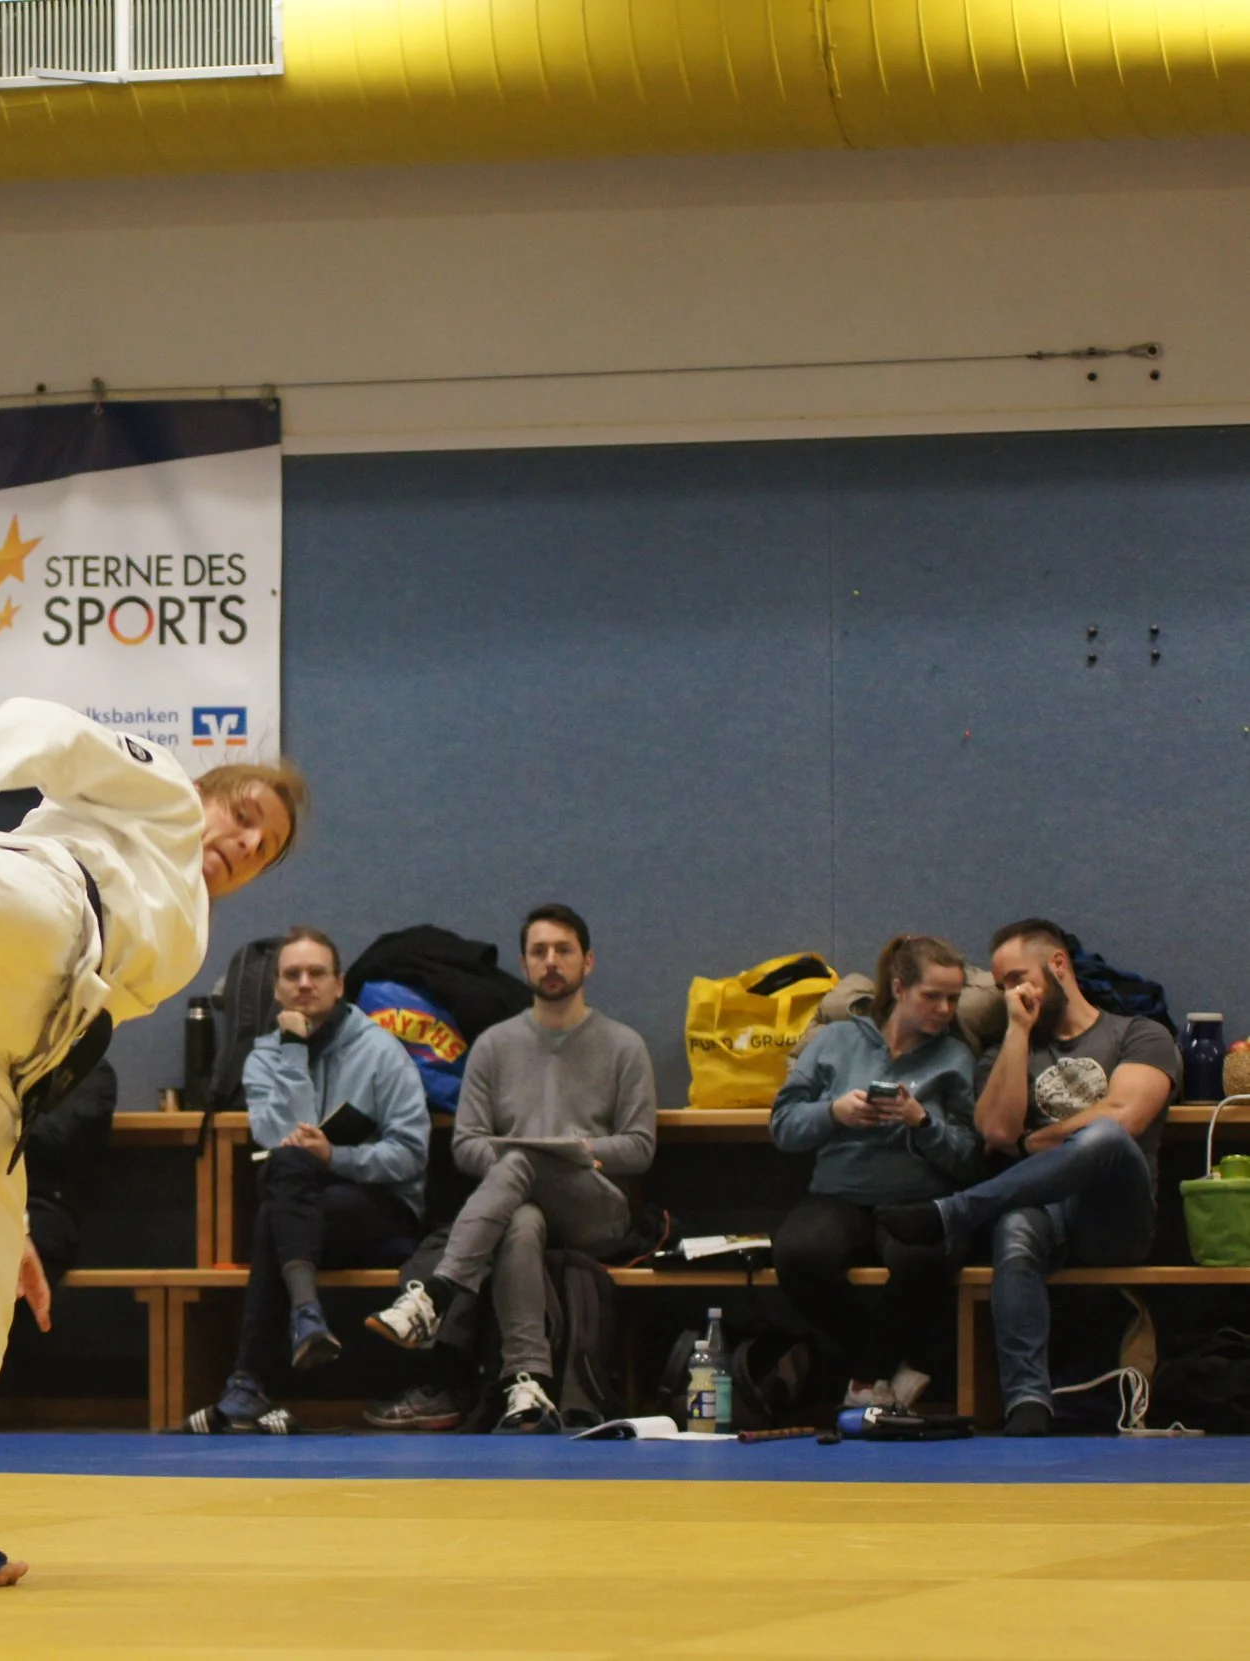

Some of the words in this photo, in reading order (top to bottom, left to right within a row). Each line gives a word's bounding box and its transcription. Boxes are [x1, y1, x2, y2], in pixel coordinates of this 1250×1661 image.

[44, 554, 173, 588] STERNE
[183, 553, 247, 586] DES
[42, 595, 248, 646] SPORTS
[81, 707, 179, 724] lksbanken
[377, 1013, 466, 1059] MYTHS
